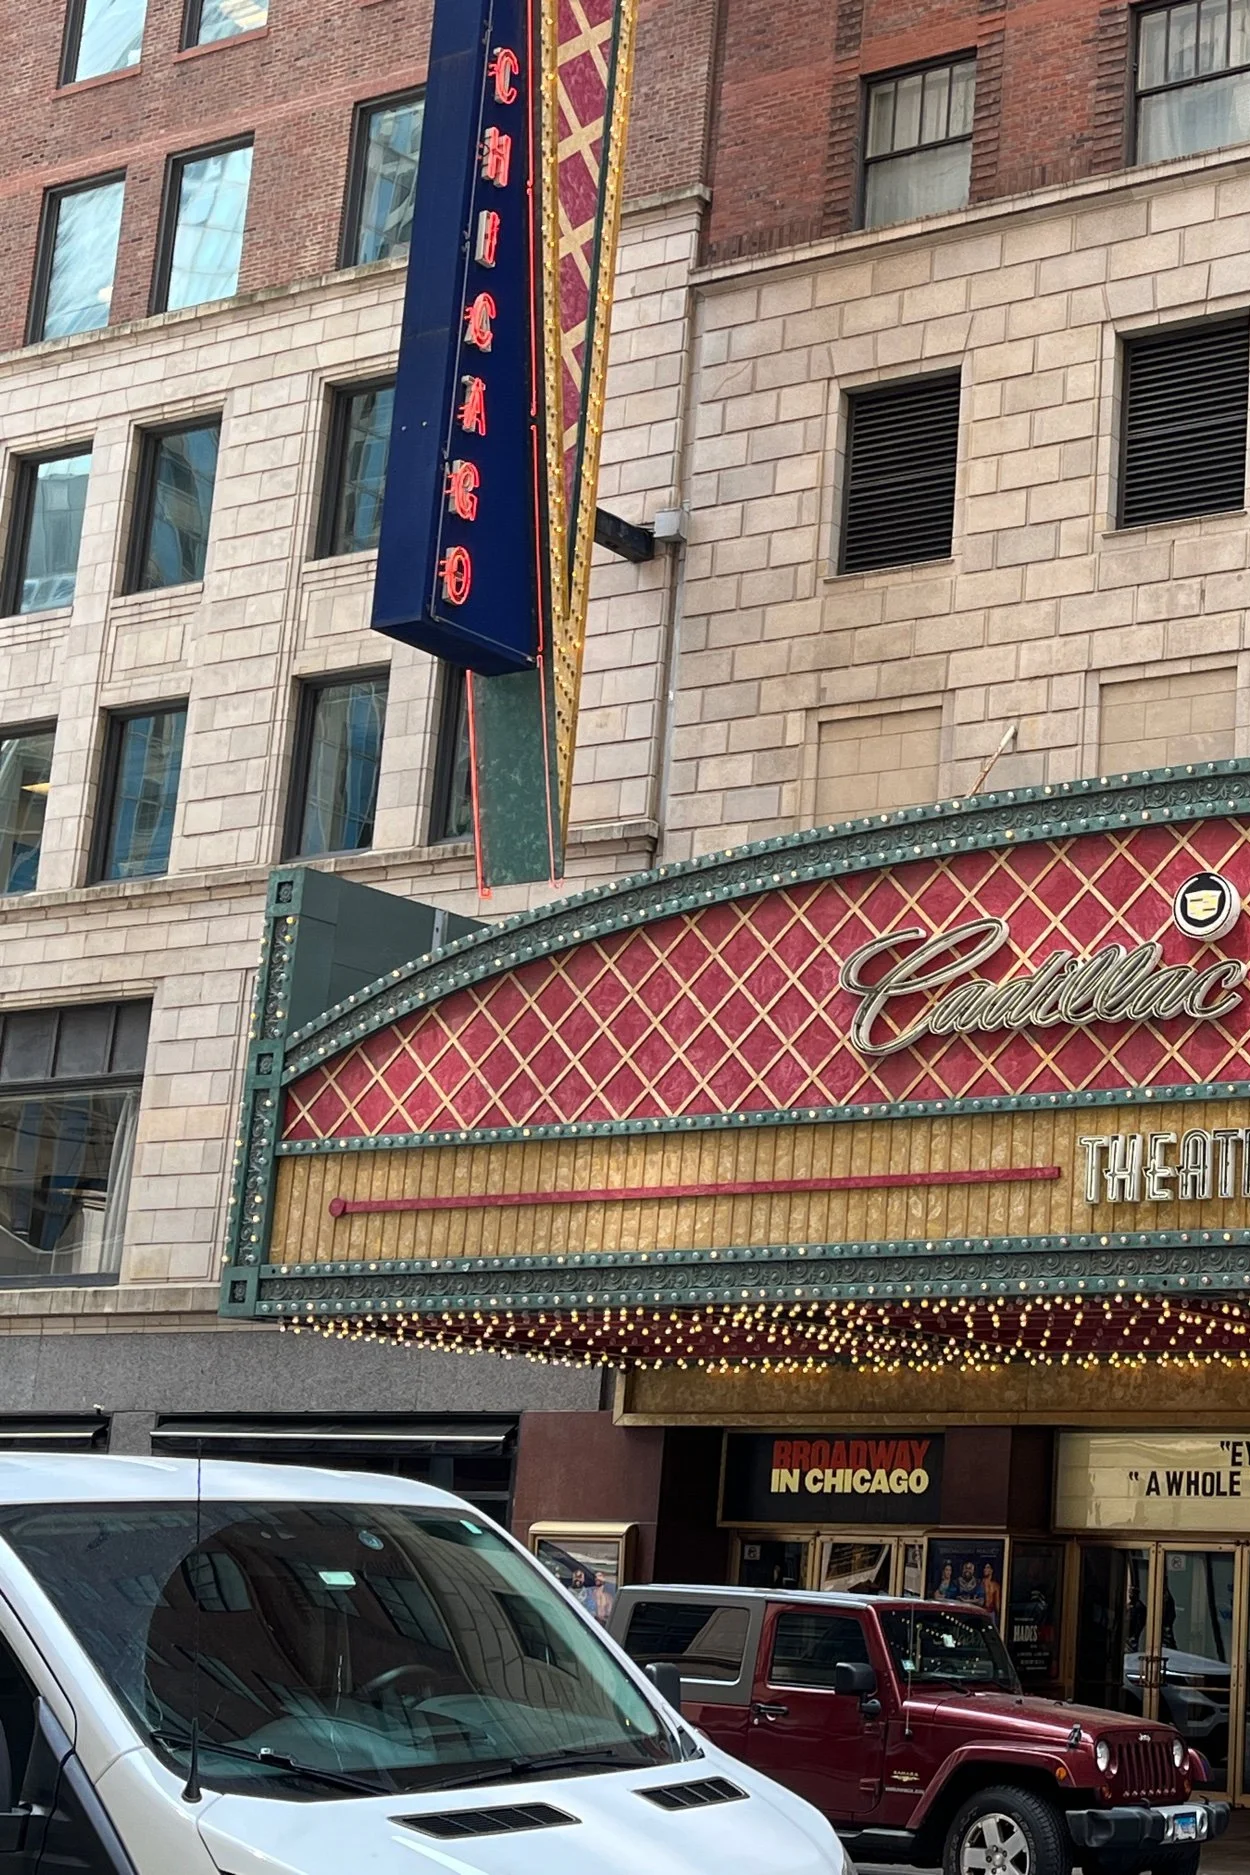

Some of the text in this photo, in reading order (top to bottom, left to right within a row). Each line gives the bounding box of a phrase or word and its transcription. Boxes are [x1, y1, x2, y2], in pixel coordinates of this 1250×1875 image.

[440, 46, 520, 607] CHICAGO
[838, 915, 1248, 1058] Cadillac
[771, 1468, 929, 1494] IN CHICAGO
[773, 1440, 931, 1471] BROADWAY
